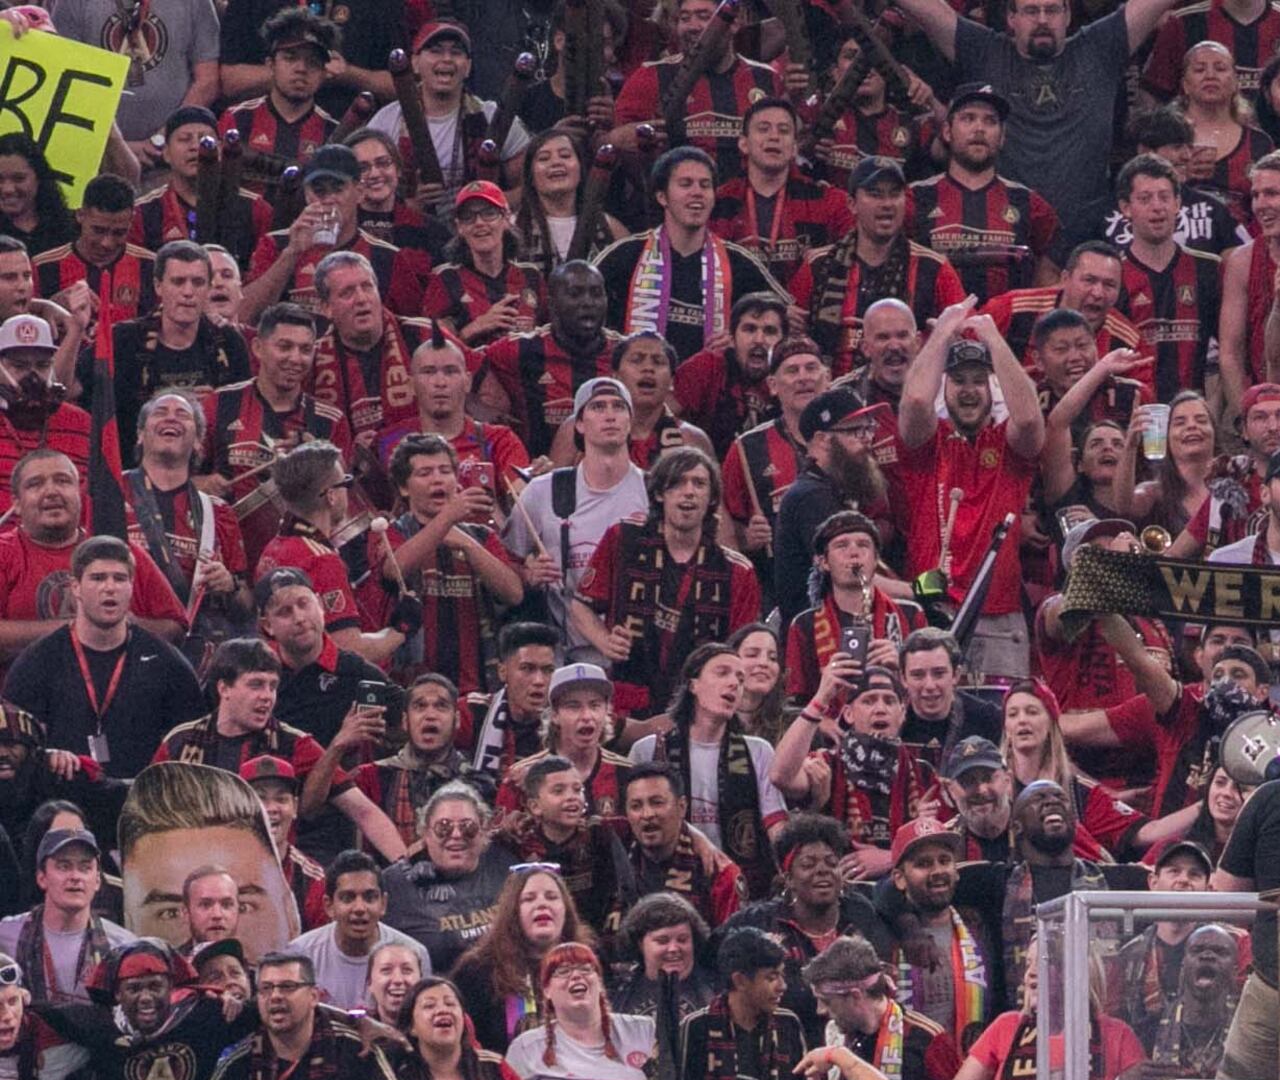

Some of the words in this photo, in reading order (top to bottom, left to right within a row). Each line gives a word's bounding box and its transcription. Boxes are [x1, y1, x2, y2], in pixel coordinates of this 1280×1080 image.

[1163, 567, 1243, 618] WE
[441, 908, 494, 932] ATLAN
[460, 924, 490, 939] UNIT
